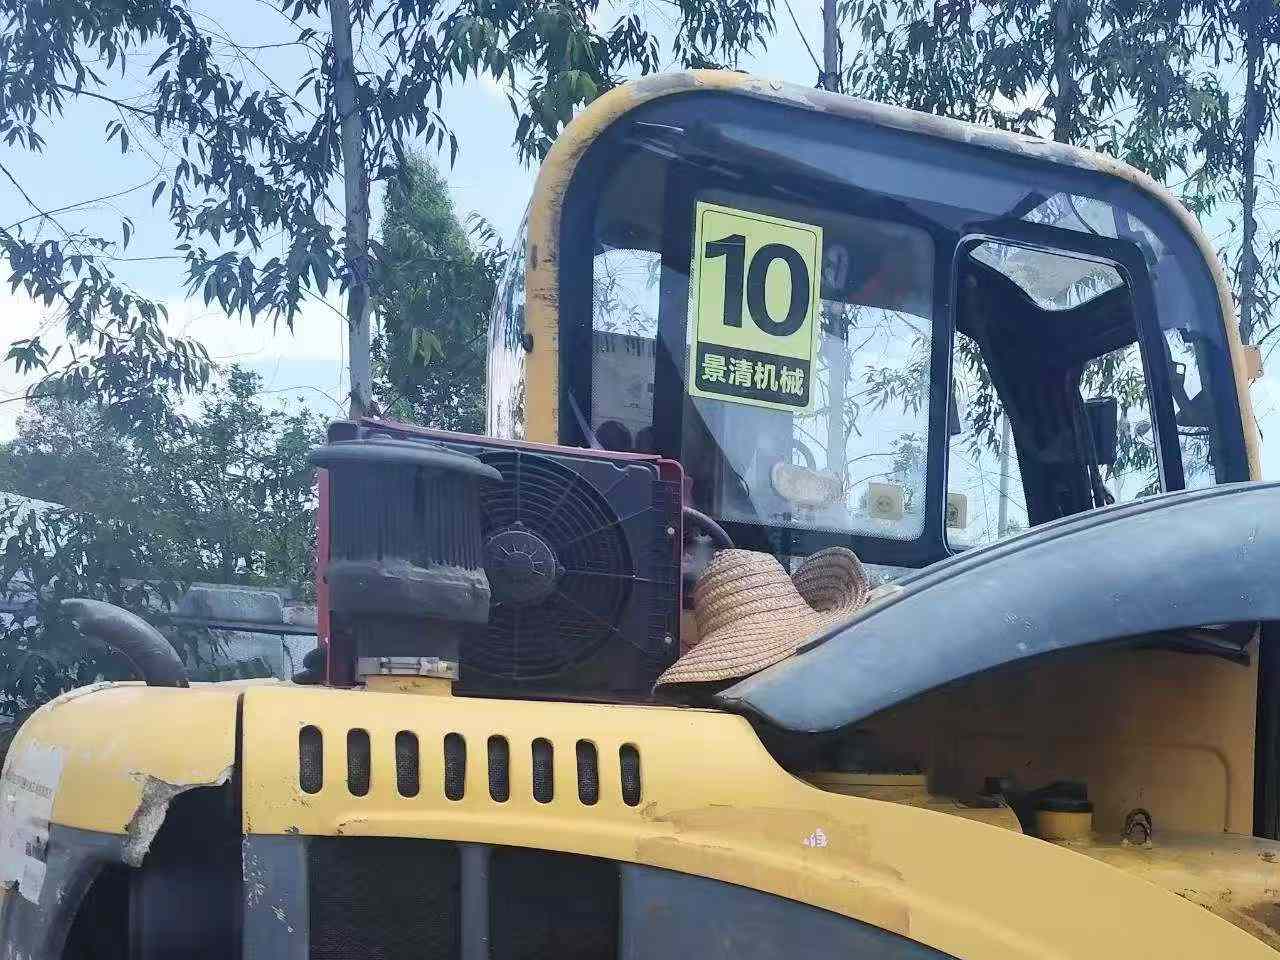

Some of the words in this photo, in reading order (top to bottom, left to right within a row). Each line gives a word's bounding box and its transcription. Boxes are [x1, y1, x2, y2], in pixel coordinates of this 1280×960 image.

[705, 233, 810, 337] 10
[701, 353, 805, 396] 景清机械
